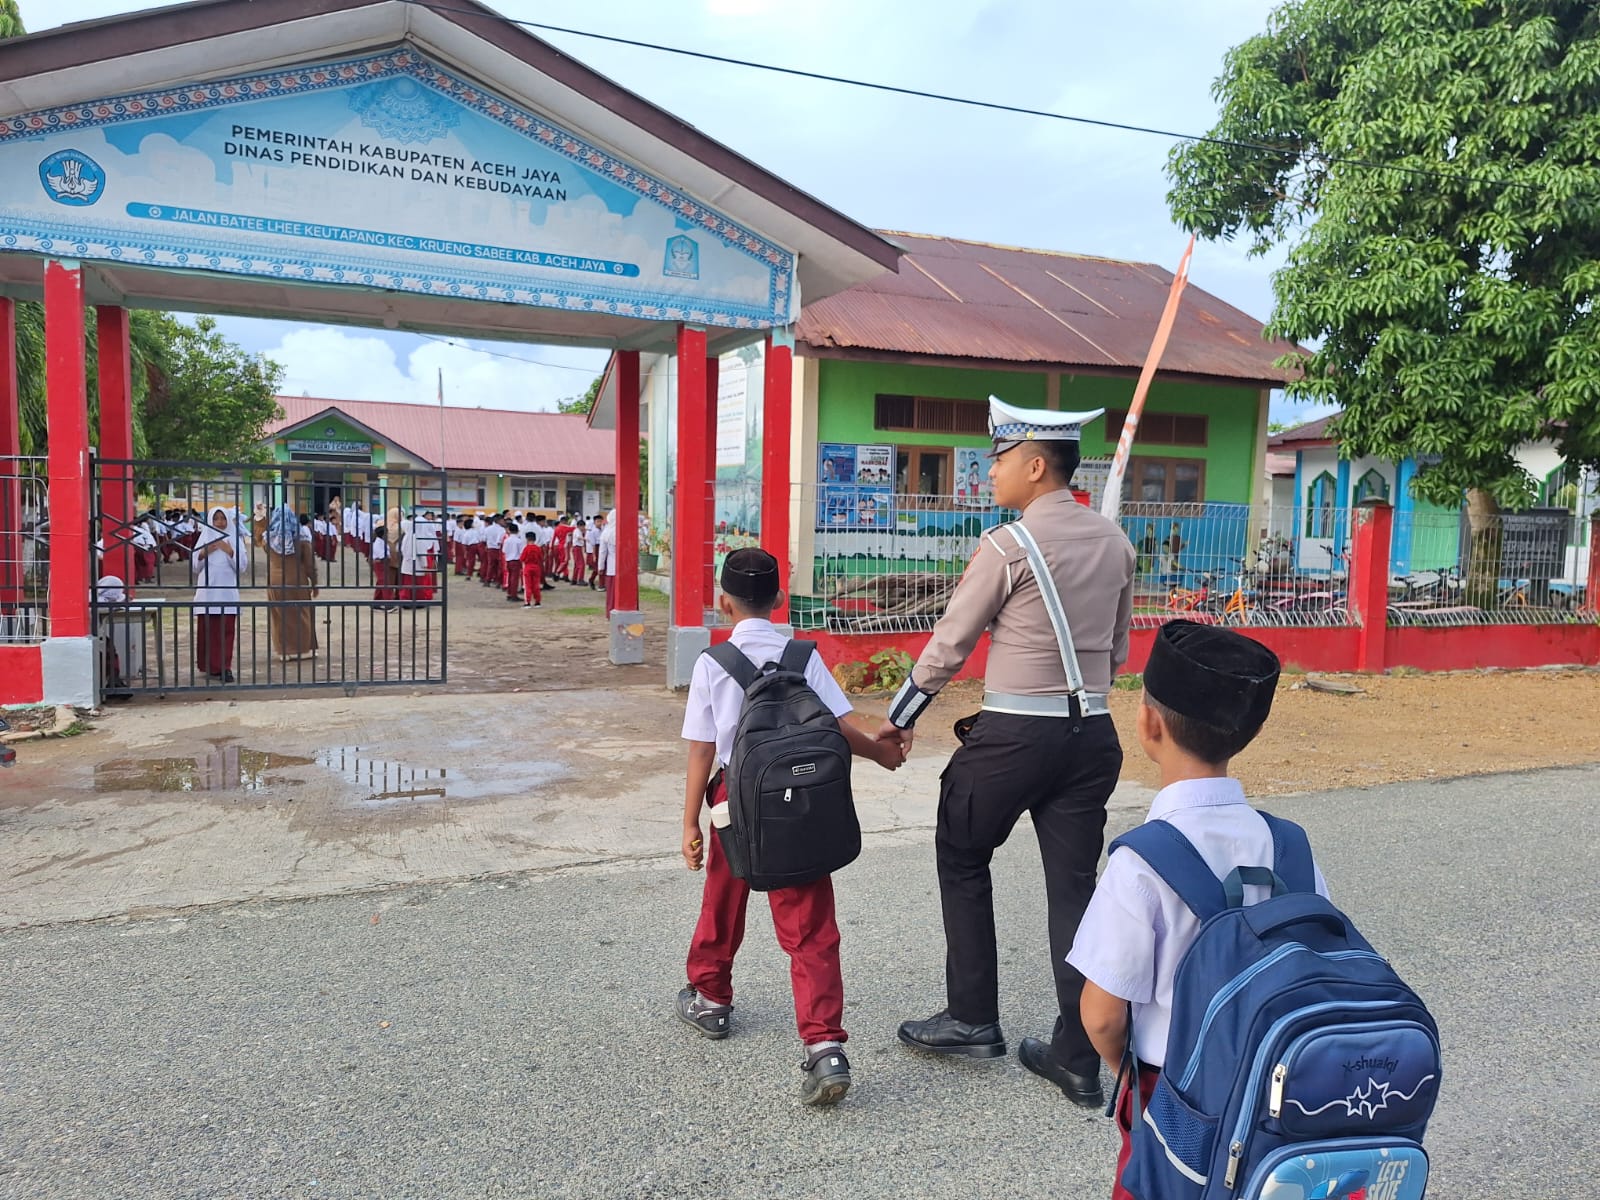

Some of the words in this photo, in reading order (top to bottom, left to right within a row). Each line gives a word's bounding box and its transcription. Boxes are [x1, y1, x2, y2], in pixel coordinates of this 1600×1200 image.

[224, 141, 284, 162] DINAS
[290, 151, 405, 179] PENDIDIKAN
[411, 168, 448, 185] DAN
[454, 174, 567, 201] KEBUDAYAAN
[232, 125, 352, 154] PEMERINTAH
[359, 143, 465, 170] KABUPATEN
[471, 160, 516, 178] ACEH
[521, 168, 561, 184] JAYA
[172, 209, 217, 225] JALAN
[220, 214, 265, 231] BATEE
[267, 221, 301, 235] LHEE
[304, 225, 385, 245] KEUTAPANG
[388, 235, 417, 249] KEC.
[419, 238, 472, 256] KRUENG
[474, 246, 513, 261] SABEE
[515, 252, 542, 265] KAB.
[544, 256, 578, 269] ACEH
[579, 261, 606, 273] JAYA
